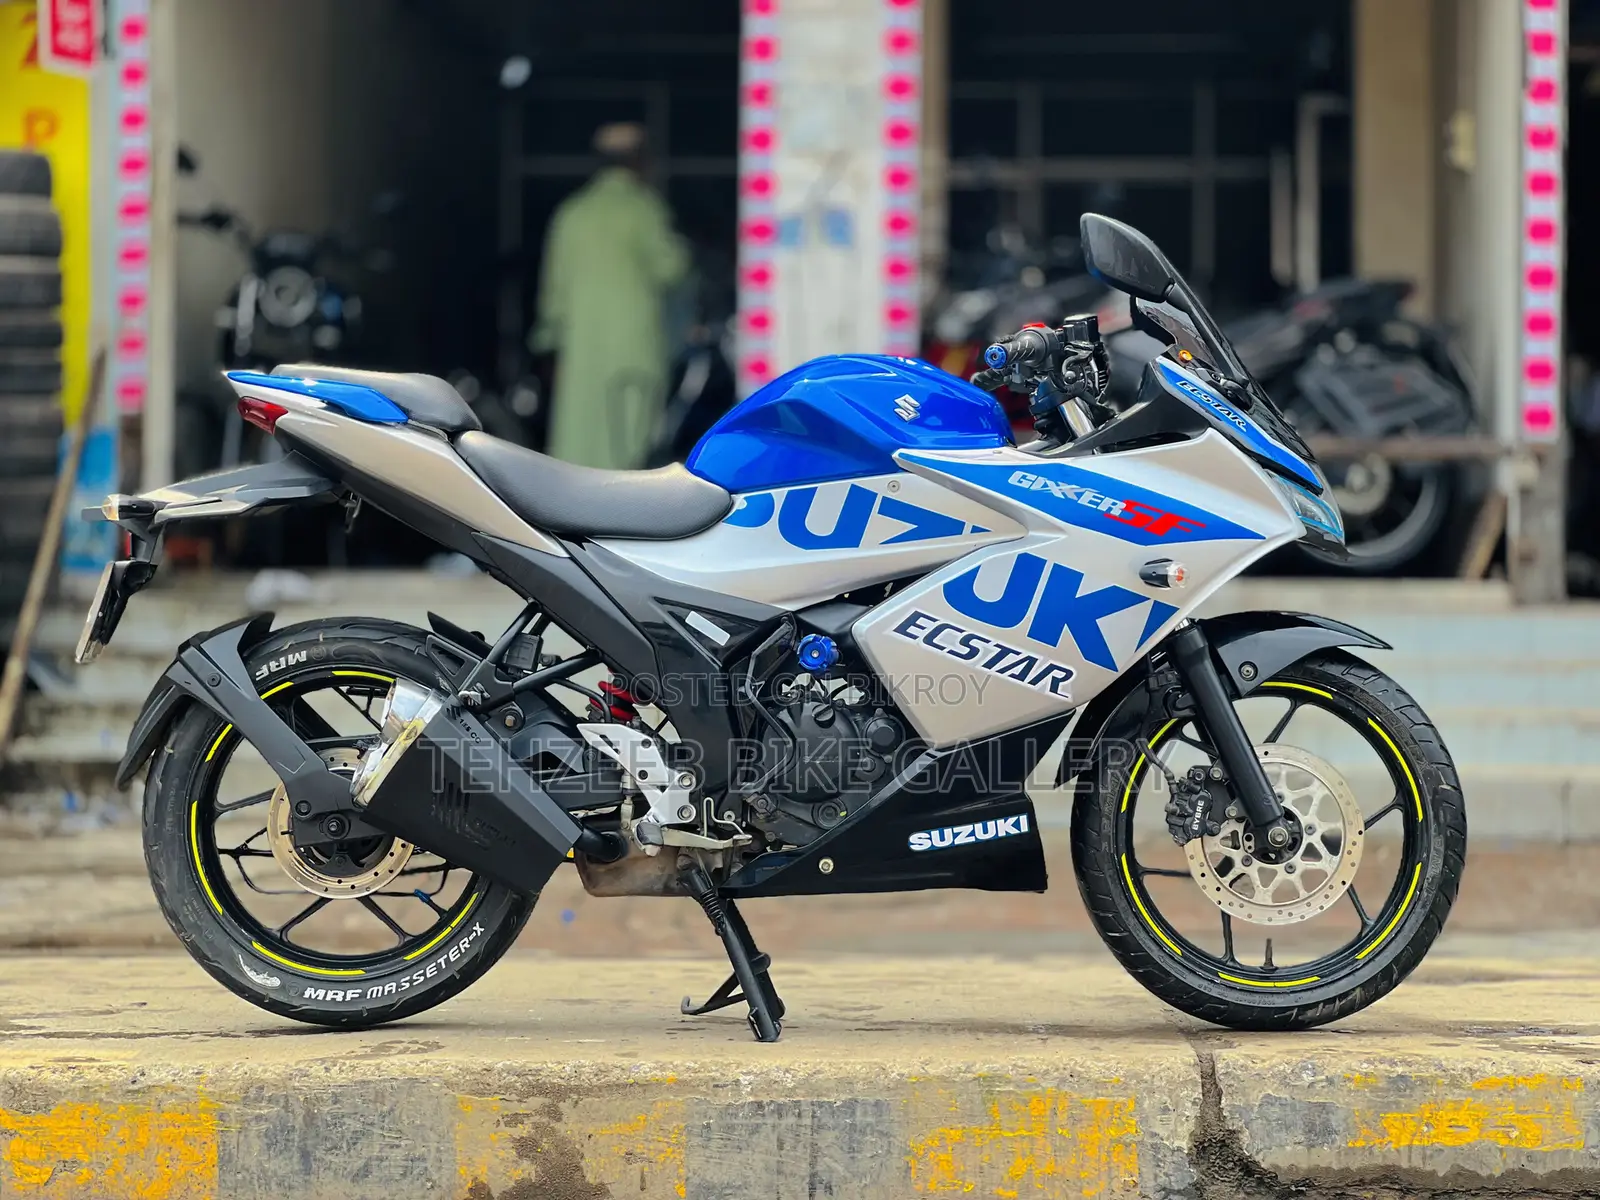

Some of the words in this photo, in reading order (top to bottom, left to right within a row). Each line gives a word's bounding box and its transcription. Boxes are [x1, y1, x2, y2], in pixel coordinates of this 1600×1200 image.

[1176, 380, 1247, 432] ECSTAR
[255, 650, 307, 681] MRF
[891, 609, 1075, 700] ECSTAR
[908, 814, 1029, 851] SUZUKI
[1192, 800, 1205, 831] BYBRE
[303, 986, 362, 1002] MRF
[366, 921, 486, 1000] MASSETER-X
